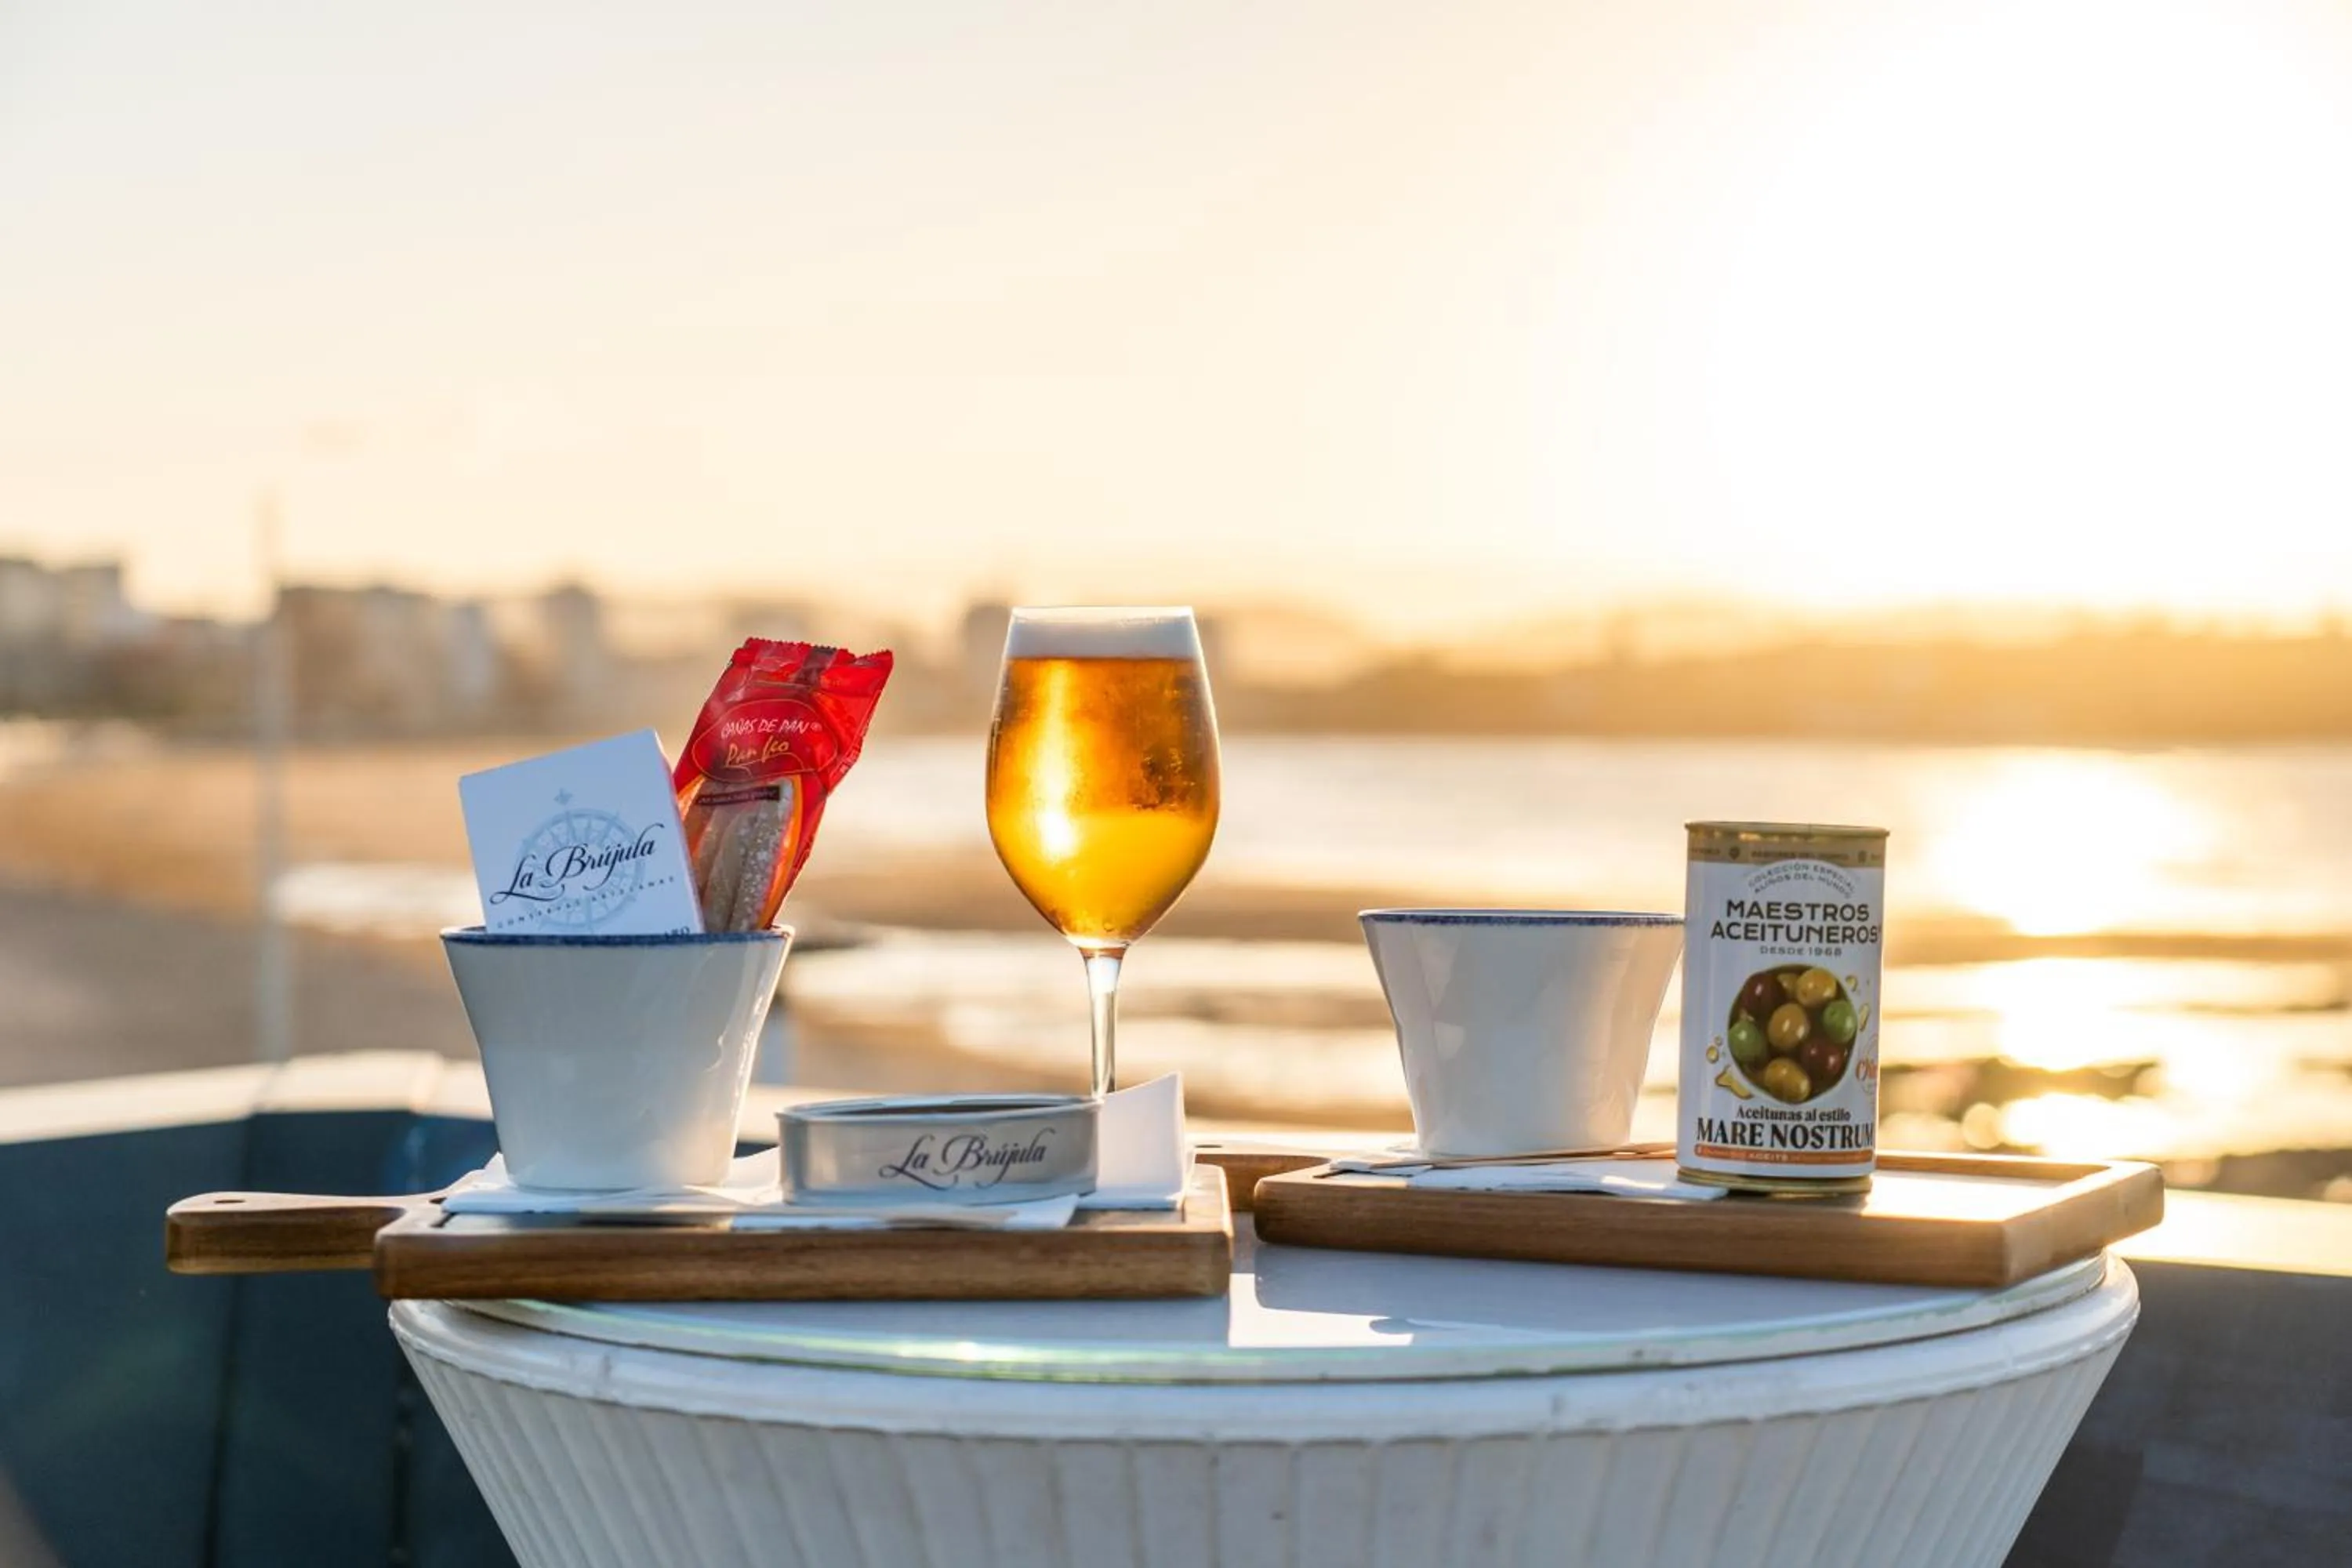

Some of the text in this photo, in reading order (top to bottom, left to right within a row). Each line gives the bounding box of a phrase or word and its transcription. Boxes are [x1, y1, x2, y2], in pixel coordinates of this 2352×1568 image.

[757, 718, 779, 733] DE
[488, 822, 665, 905] La Brújula
[1726, 898, 1870, 923] MAESTROS
[1710, 920, 1878, 944] ACEITUNEROS
[1759, 945, 1842, 957] DESDE 1968
[1735, 1105, 1852, 1122] Aceitunas al estilo
[1696, 1116, 1764, 1147] MARE
[878, 1127, 1056, 1191] La Brújula
